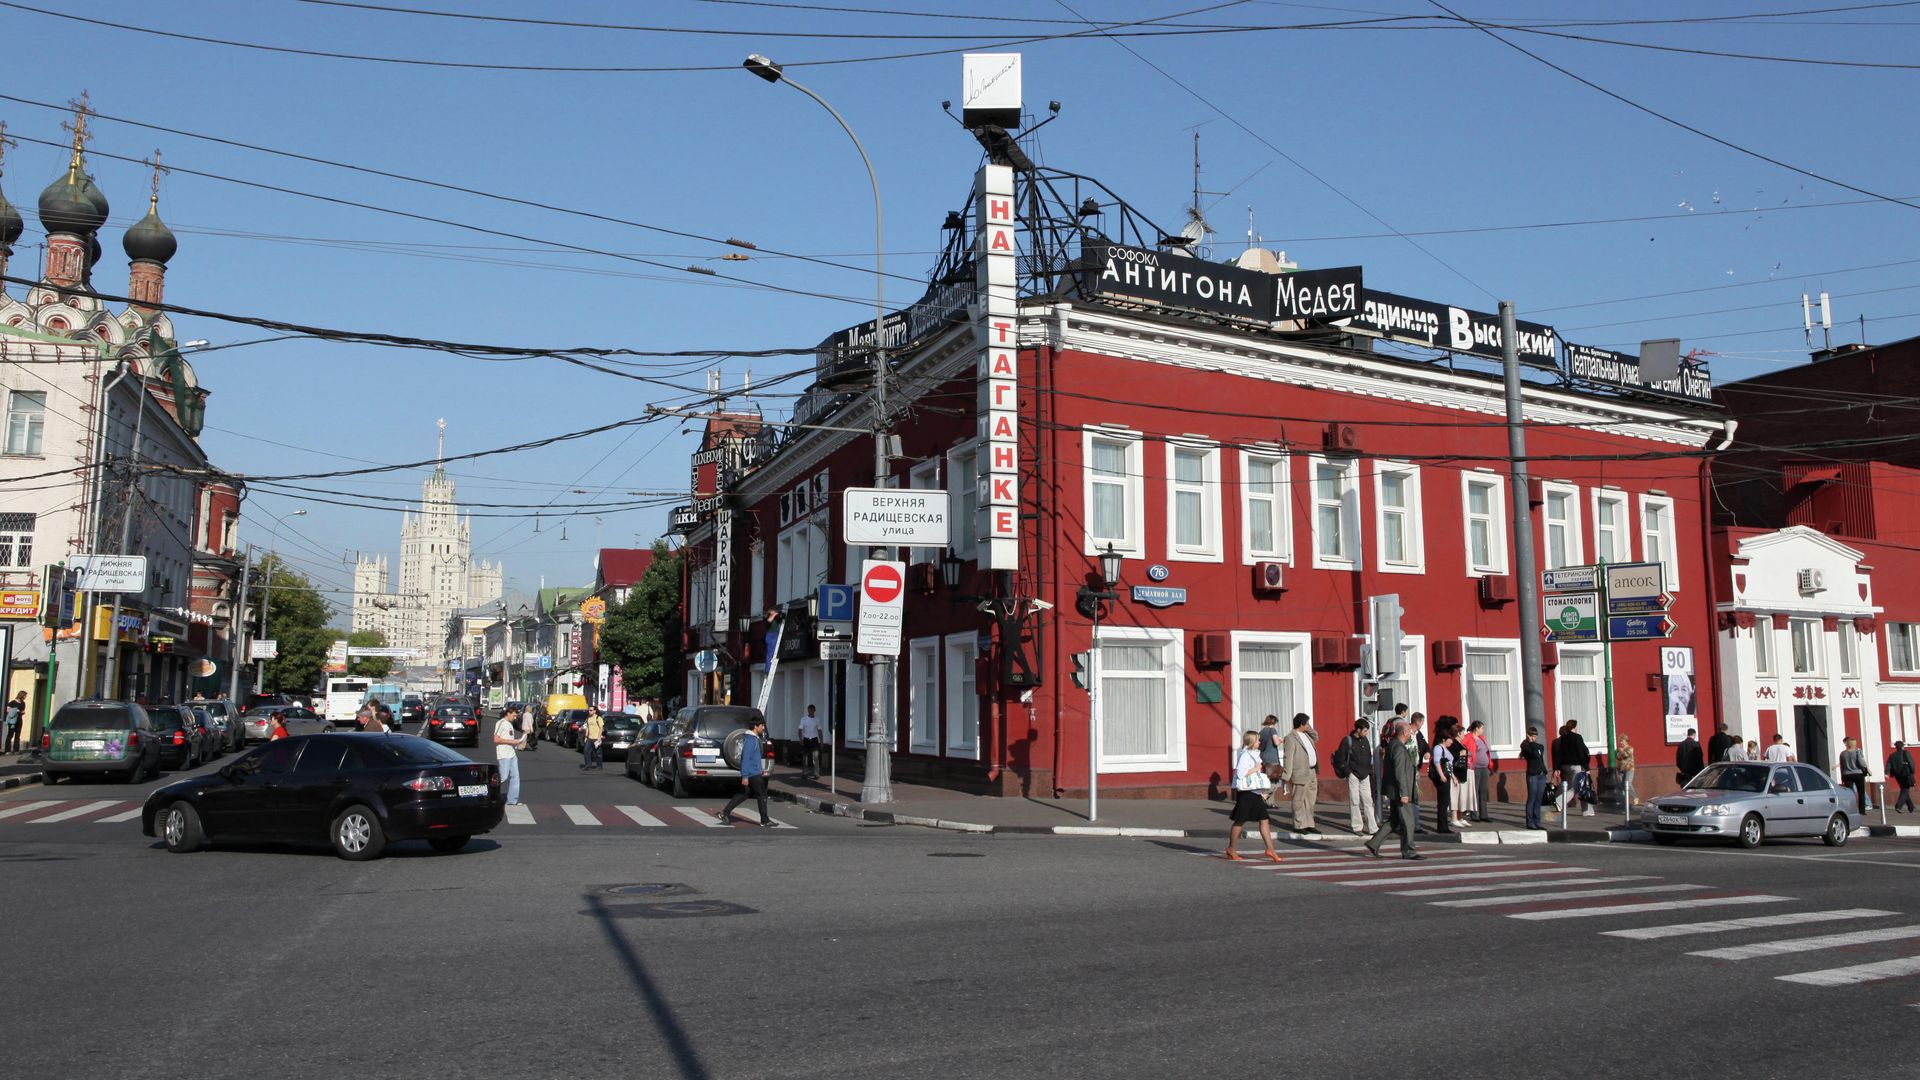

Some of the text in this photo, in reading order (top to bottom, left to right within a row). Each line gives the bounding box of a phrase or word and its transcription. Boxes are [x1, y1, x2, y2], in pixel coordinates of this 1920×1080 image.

[1107, 246, 1159, 267] СОФОКЛ
[1101, 258, 1253, 308] АНТИГОНА
[1275, 278, 1356, 317] Медея
[1329, 300, 1556, 358] адимир Выский
[1568, 346, 1644, 387] Театральный рома
[1683, 367, 1712, 400] Онегин
[993, 321, 1013, 533] ТАГАНКЕ
[872, 497, 925, 508] ВЕРХНЯЯ
[853, 511, 943, 524] РАДИЩЕВСКАЯ
[882, 526, 915, 536] улица
[718, 510, 730, 613] ШАРАШКА
[1154, 567, 1165, 577] 76
[88, 569, 143, 578] РАДИЩЕВСКАЯ
[828, 588, 847, 617] P
[1547, 597, 1592, 606] СТОМАТОЛОГИЯ
[542, 657, 550, 667] P
[1667, 651, 1686, 669] 90
